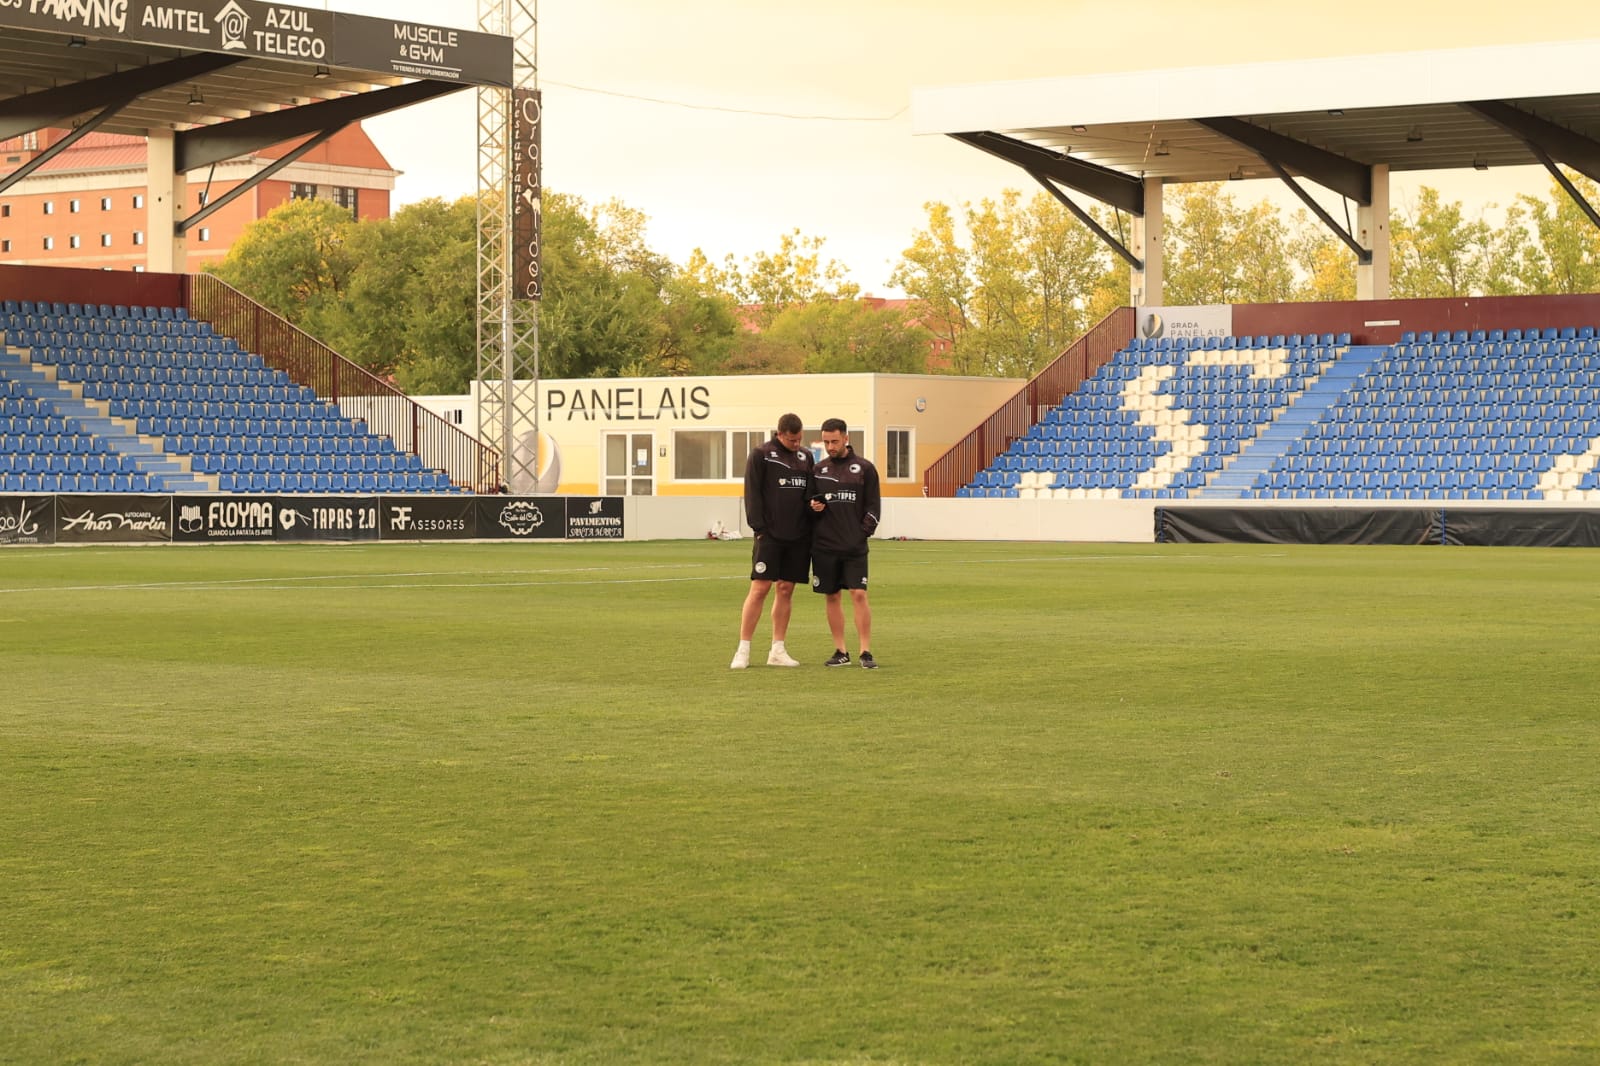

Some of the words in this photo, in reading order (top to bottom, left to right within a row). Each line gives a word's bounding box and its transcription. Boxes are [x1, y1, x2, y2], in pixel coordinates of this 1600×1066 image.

[141, 5, 210, 34] AMTEL
[265, 7, 314, 32] AZUL
[253, 30, 325, 58] TELECO
[394, 23, 458, 47] MUSCLE
[399, 44, 407, 57] &
[409, 44, 444, 64] GYM
[513, 98, 521, 214] restaurante
[1170, 329, 1225, 338] PANELAIS
[547, 385, 710, 421] PANELAIS
[208, 501, 273, 529] FLOYMA
[312, 508, 353, 529] TAPAS
[358, 508, 376, 529] 2.0
[391, 506, 412, 530] RF
[409, 519, 465, 530] ASESORES
[569, 517, 622, 526] PAVIMENTOS
[207, 529, 228, 537] CUANDO
[569, 527, 594, 538] SANTA
[594, 527, 623, 538] MARTA
